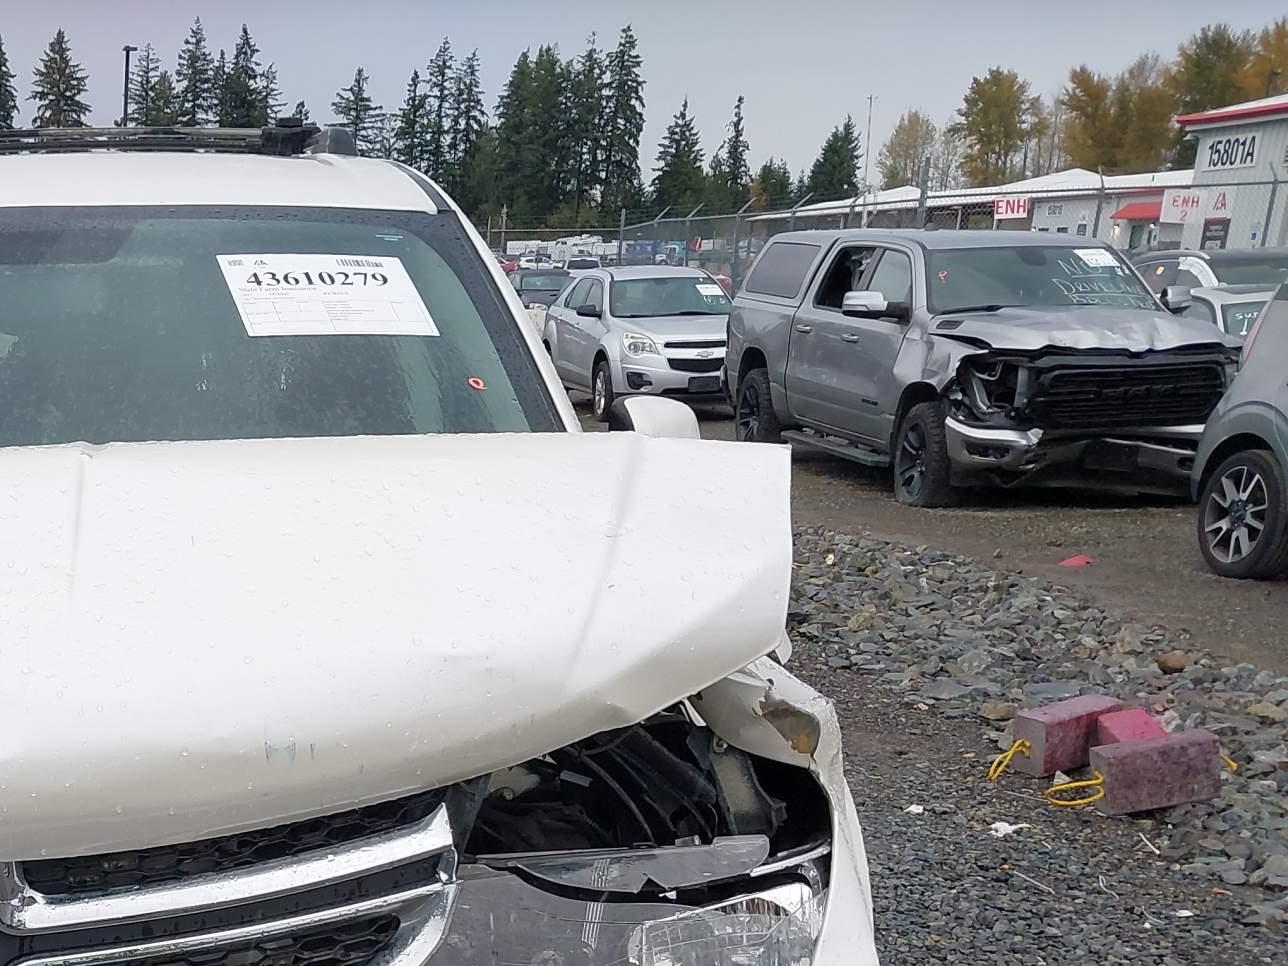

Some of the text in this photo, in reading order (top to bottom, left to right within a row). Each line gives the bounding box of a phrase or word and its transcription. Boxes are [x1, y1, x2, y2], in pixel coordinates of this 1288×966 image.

[1208, 135, 1256, 168] 15801A
[995, 199, 1027, 215] ENH
[1172, 195, 1200, 208] ENH
[246, 271, 388, 286] 43610279
